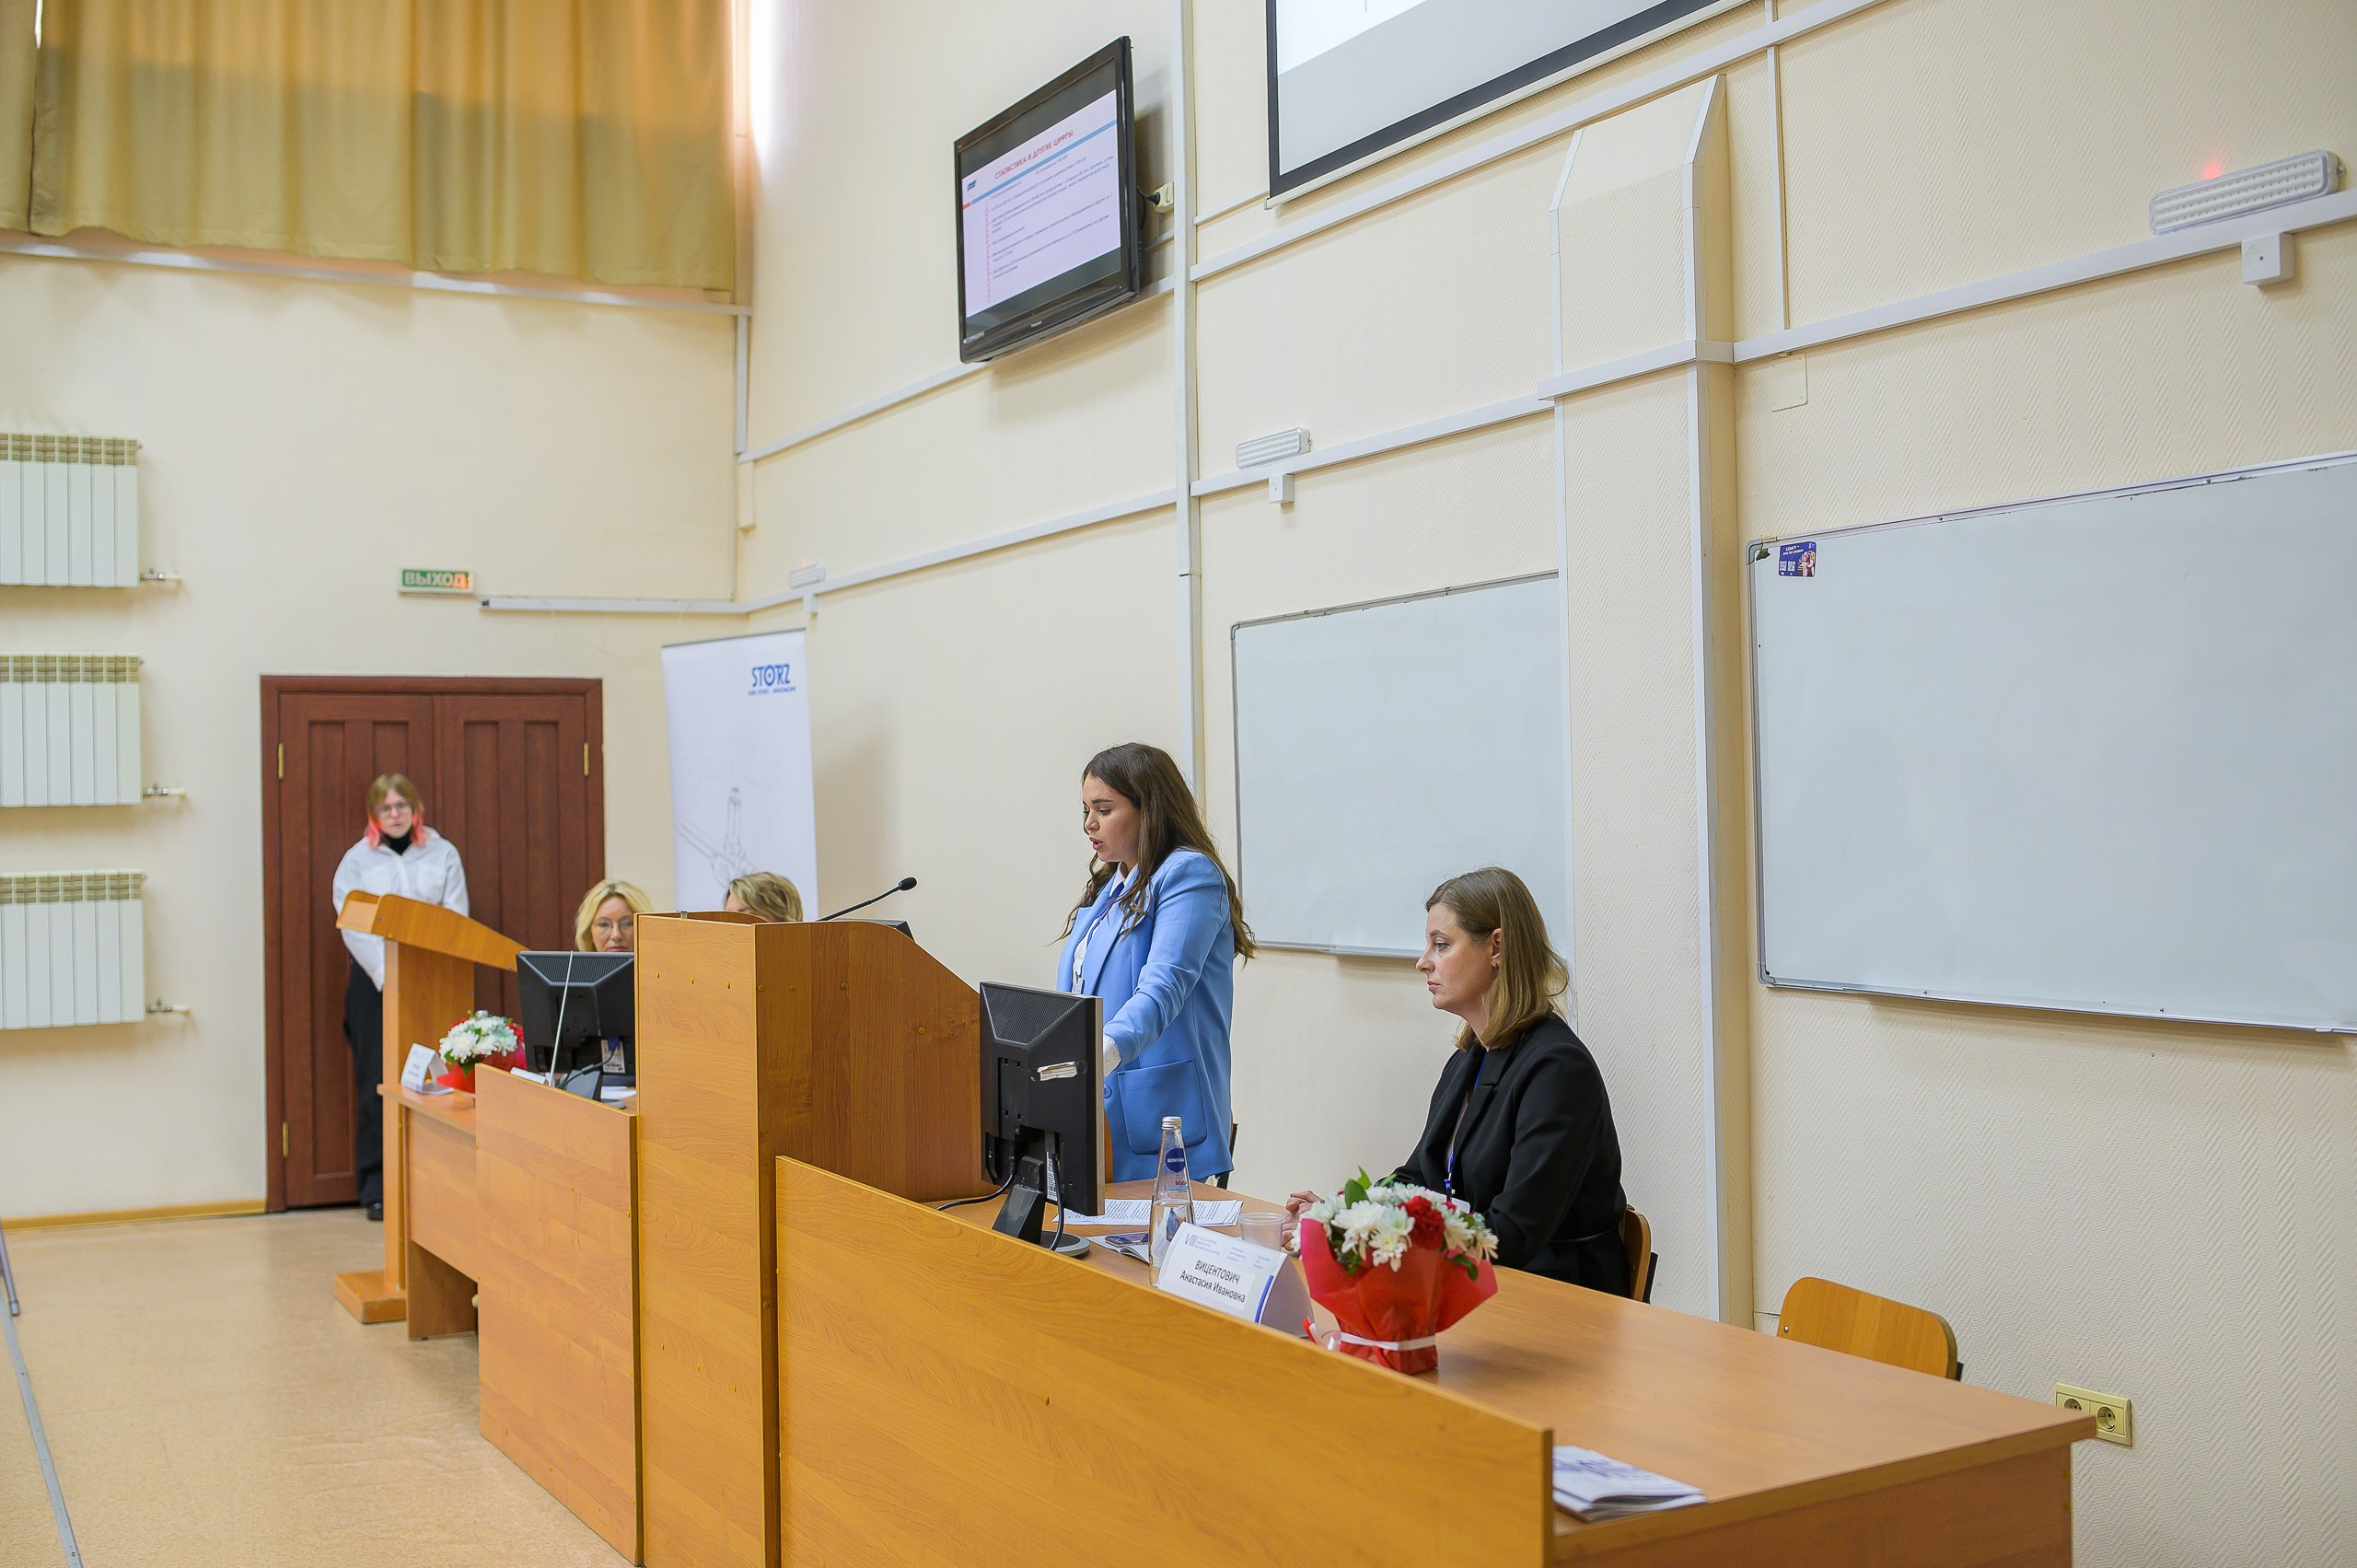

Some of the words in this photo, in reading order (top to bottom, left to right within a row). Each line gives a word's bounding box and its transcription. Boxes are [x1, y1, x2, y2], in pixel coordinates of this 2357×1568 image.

[1032, 141, 1052, 158] ДРУГИЕ
[405, 571, 468, 588] ВЫХОД
[751, 664, 790, 687] STORZ
[1195, 1259, 1241, 1284] ВИЦЕНТОВИЧ
[1179, 1270, 1213, 1291] Анастасия
[1213, 1281, 1246, 1303] Ивановна
